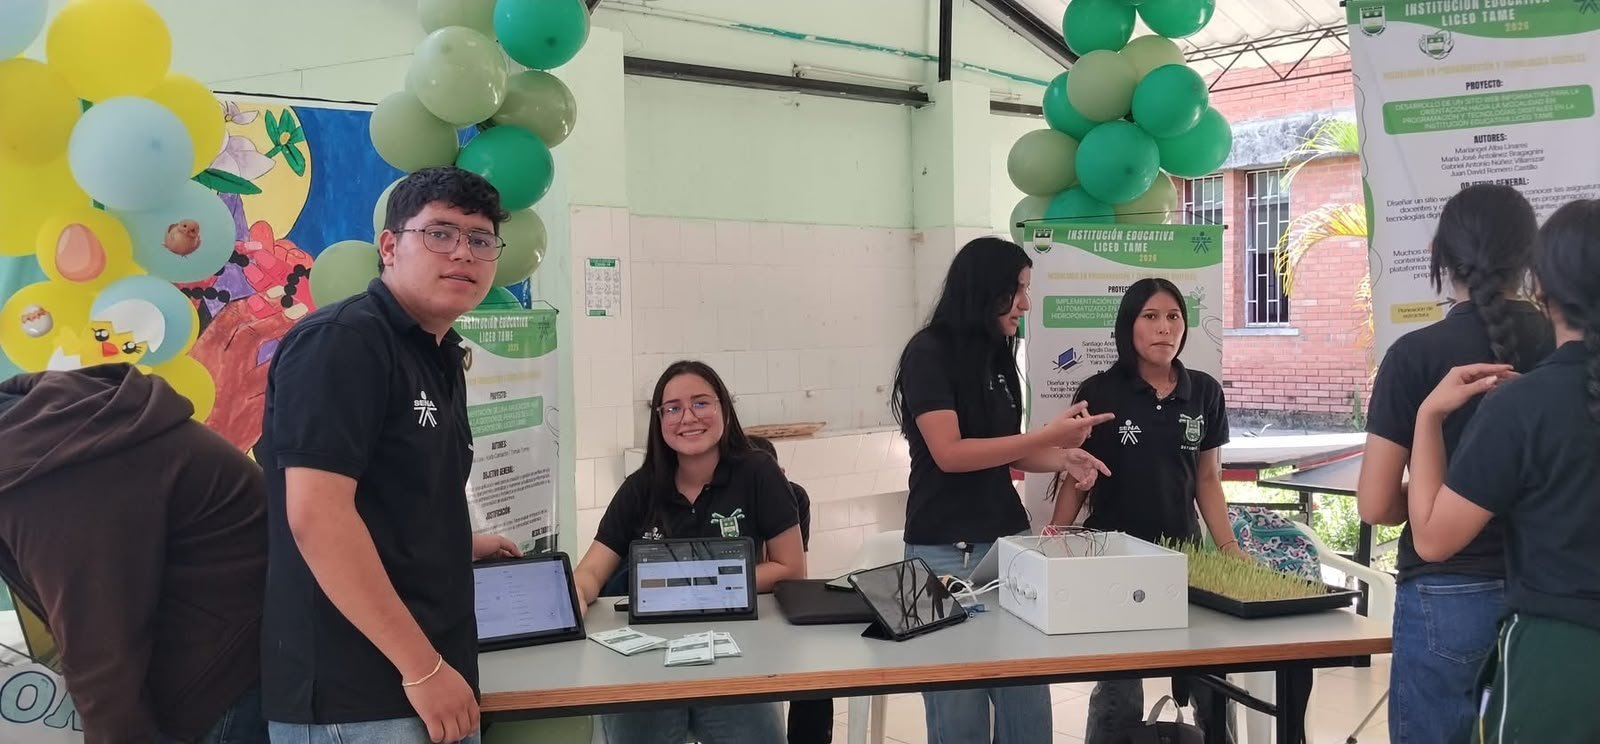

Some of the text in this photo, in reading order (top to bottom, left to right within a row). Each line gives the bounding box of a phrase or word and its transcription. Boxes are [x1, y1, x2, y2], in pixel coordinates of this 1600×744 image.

[1442, 9, 1515, 26] LICEO TAME
[1466, 79, 1503, 91] PROYECTO:
[1474, 133, 1508, 143] AUTORES:
[1441, 162, 1464, 170] Gabriel
[1465, 160, 1490, 168] Antonio
[1514, 163, 1537, 171] Castillo
[1525, 187, 1552, 195] conocer
[1566, 184, 1600, 193] asignatura
[1386, 198, 1412, 206] Diseñar
[1399, 205, 1432, 214] docentes
[1067, 228, 1174, 241] INSTITUCIÓN EDUCATIVA
[1094, 242, 1148, 252] LICEO TAME
[1393, 249, 1422, 257] Muchos
[1389, 264, 1427, 274] plataforma
[1108, 285, 1129, 293] PROYEC
[1056, 296, 1110, 305] IMPLEMENTACIÓN
[1096, 312, 1113, 320] PARA
[1047, 379, 1065, 387] Diseñar
[1041, 392, 1072, 400] tecnológicos
[413, 399, 435, 408] SENA
